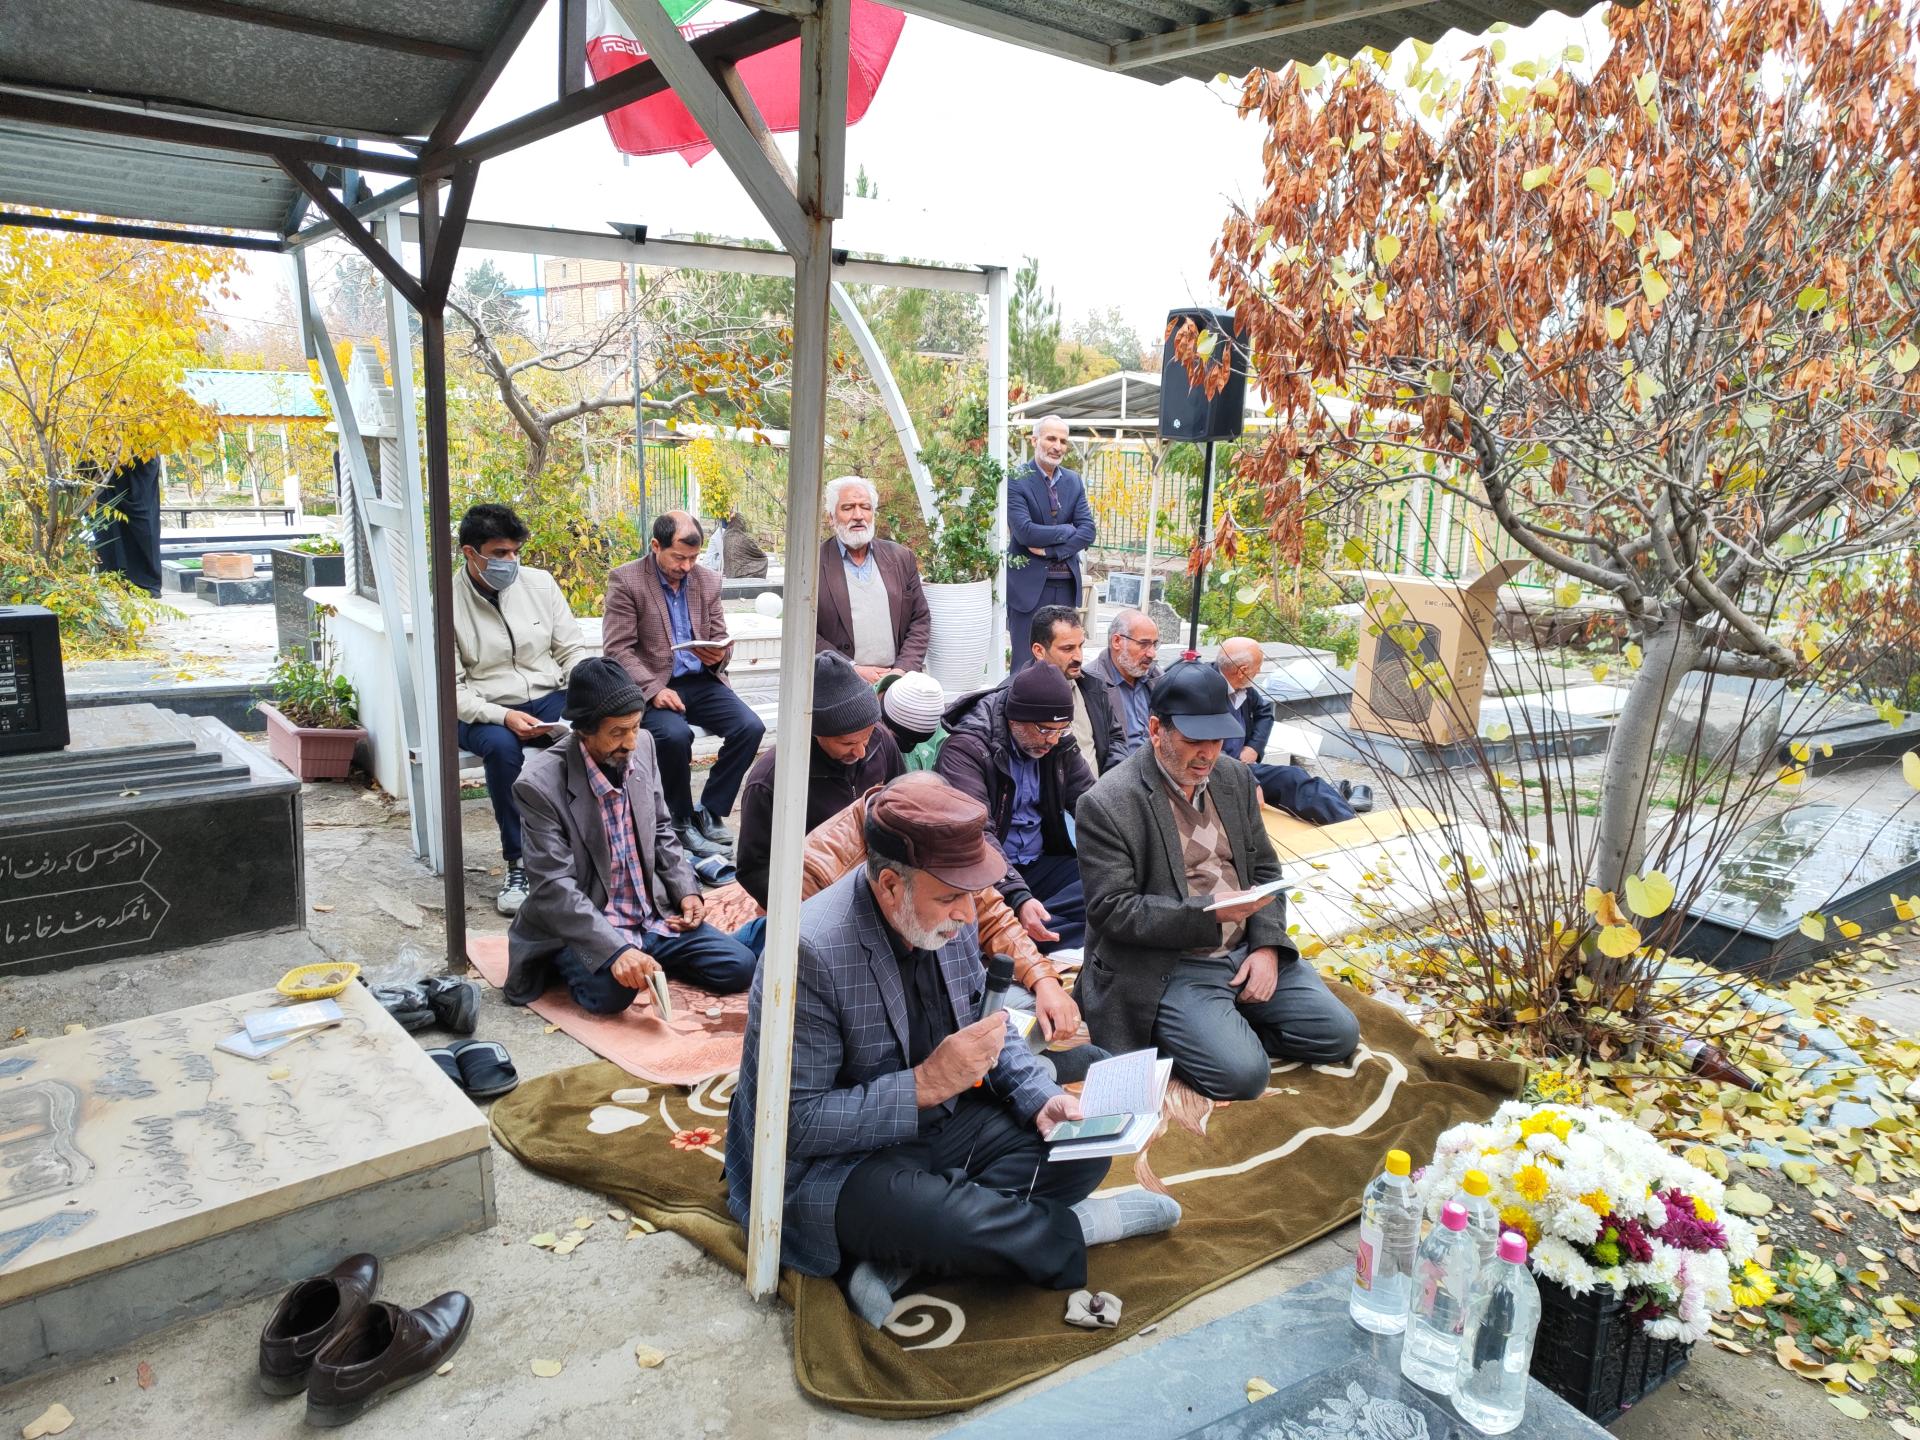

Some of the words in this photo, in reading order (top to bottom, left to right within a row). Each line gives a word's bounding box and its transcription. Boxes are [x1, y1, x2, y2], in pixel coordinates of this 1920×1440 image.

[13, 852, 57, 879] رفت
[56, 842, 91, 874] که
[76, 832, 145, 873] افسوس
[5, 922, 15, 944] ما
[18, 914, 52, 943] خانه
[47, 910, 102, 938] شد
